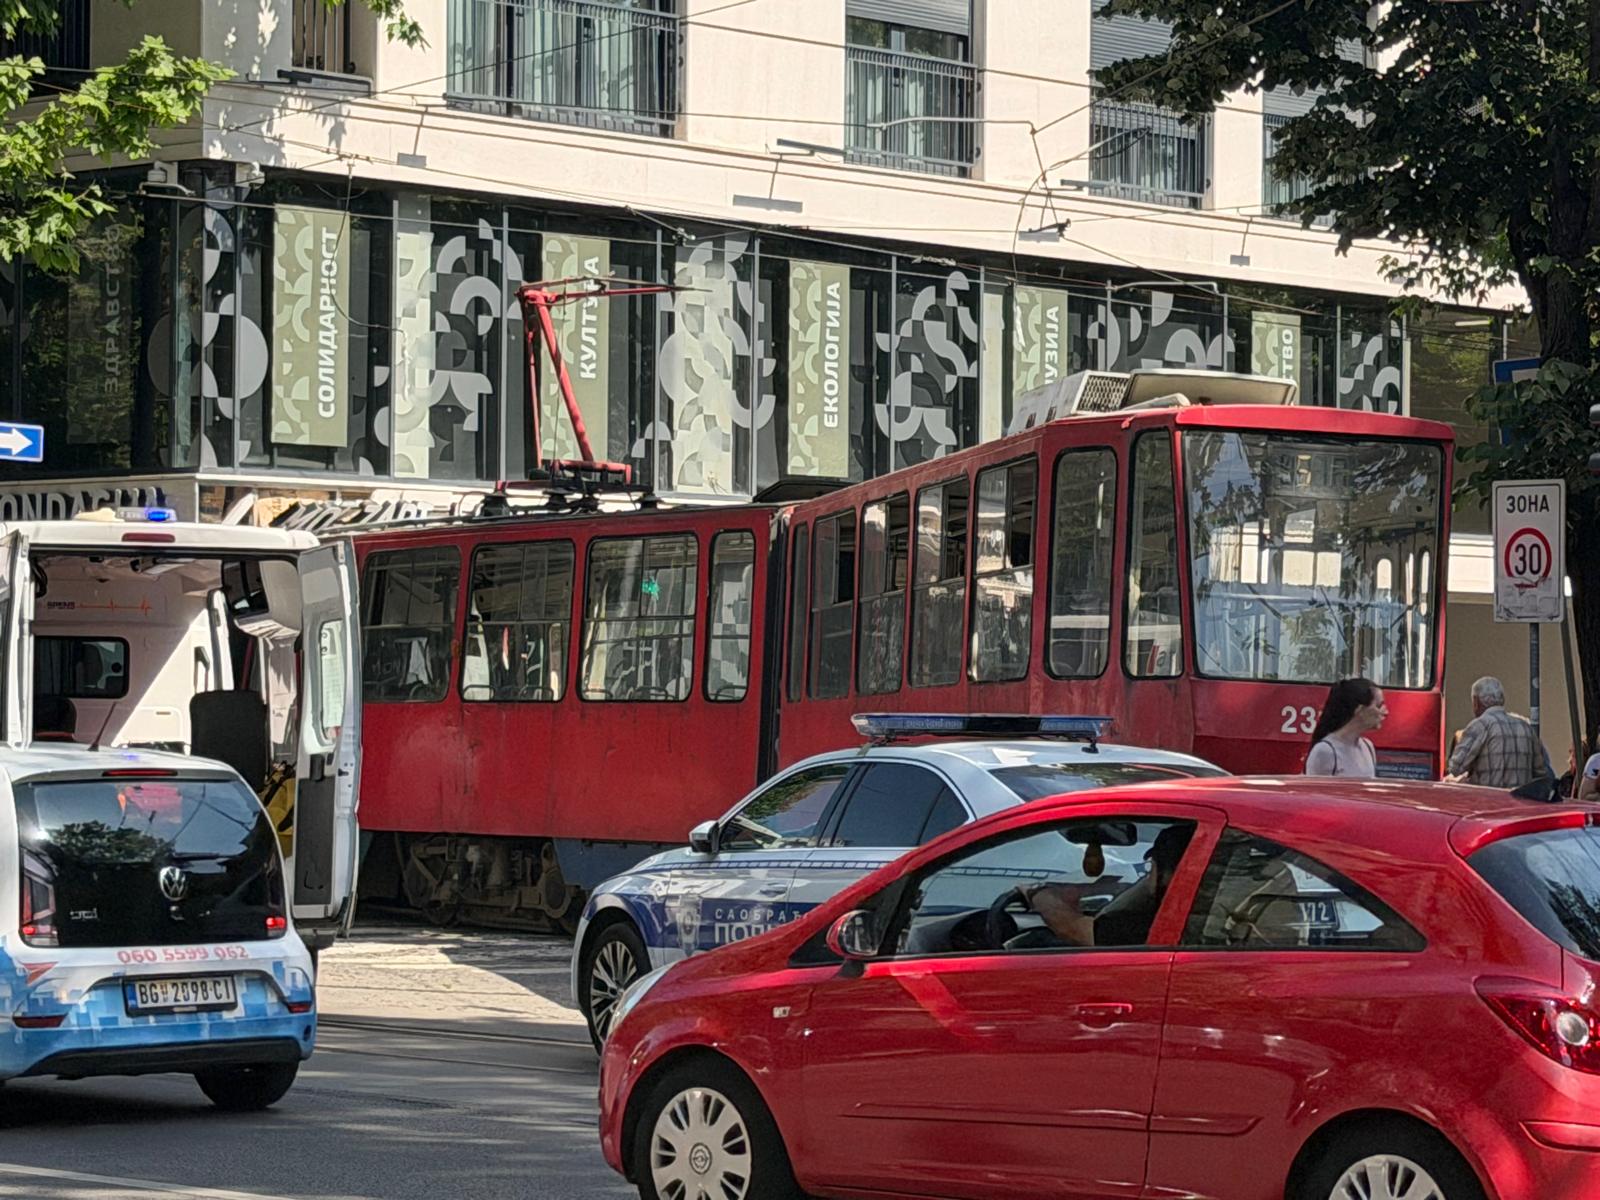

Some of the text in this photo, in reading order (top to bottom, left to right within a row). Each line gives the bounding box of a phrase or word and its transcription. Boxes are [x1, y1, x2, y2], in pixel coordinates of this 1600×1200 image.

[318, 227, 338, 418] СОЛИДАРНОСТ
[823, 282, 841, 428] ЕКОЛОГИЈА
[1506, 494, 1550, 513] ЗОНА
[1514, 543, 1542, 575] 30
[1280, 705, 1322, 734] 23
[117, 945, 249, 964] 060 5599 062
[139, 983, 159, 1004] BG
